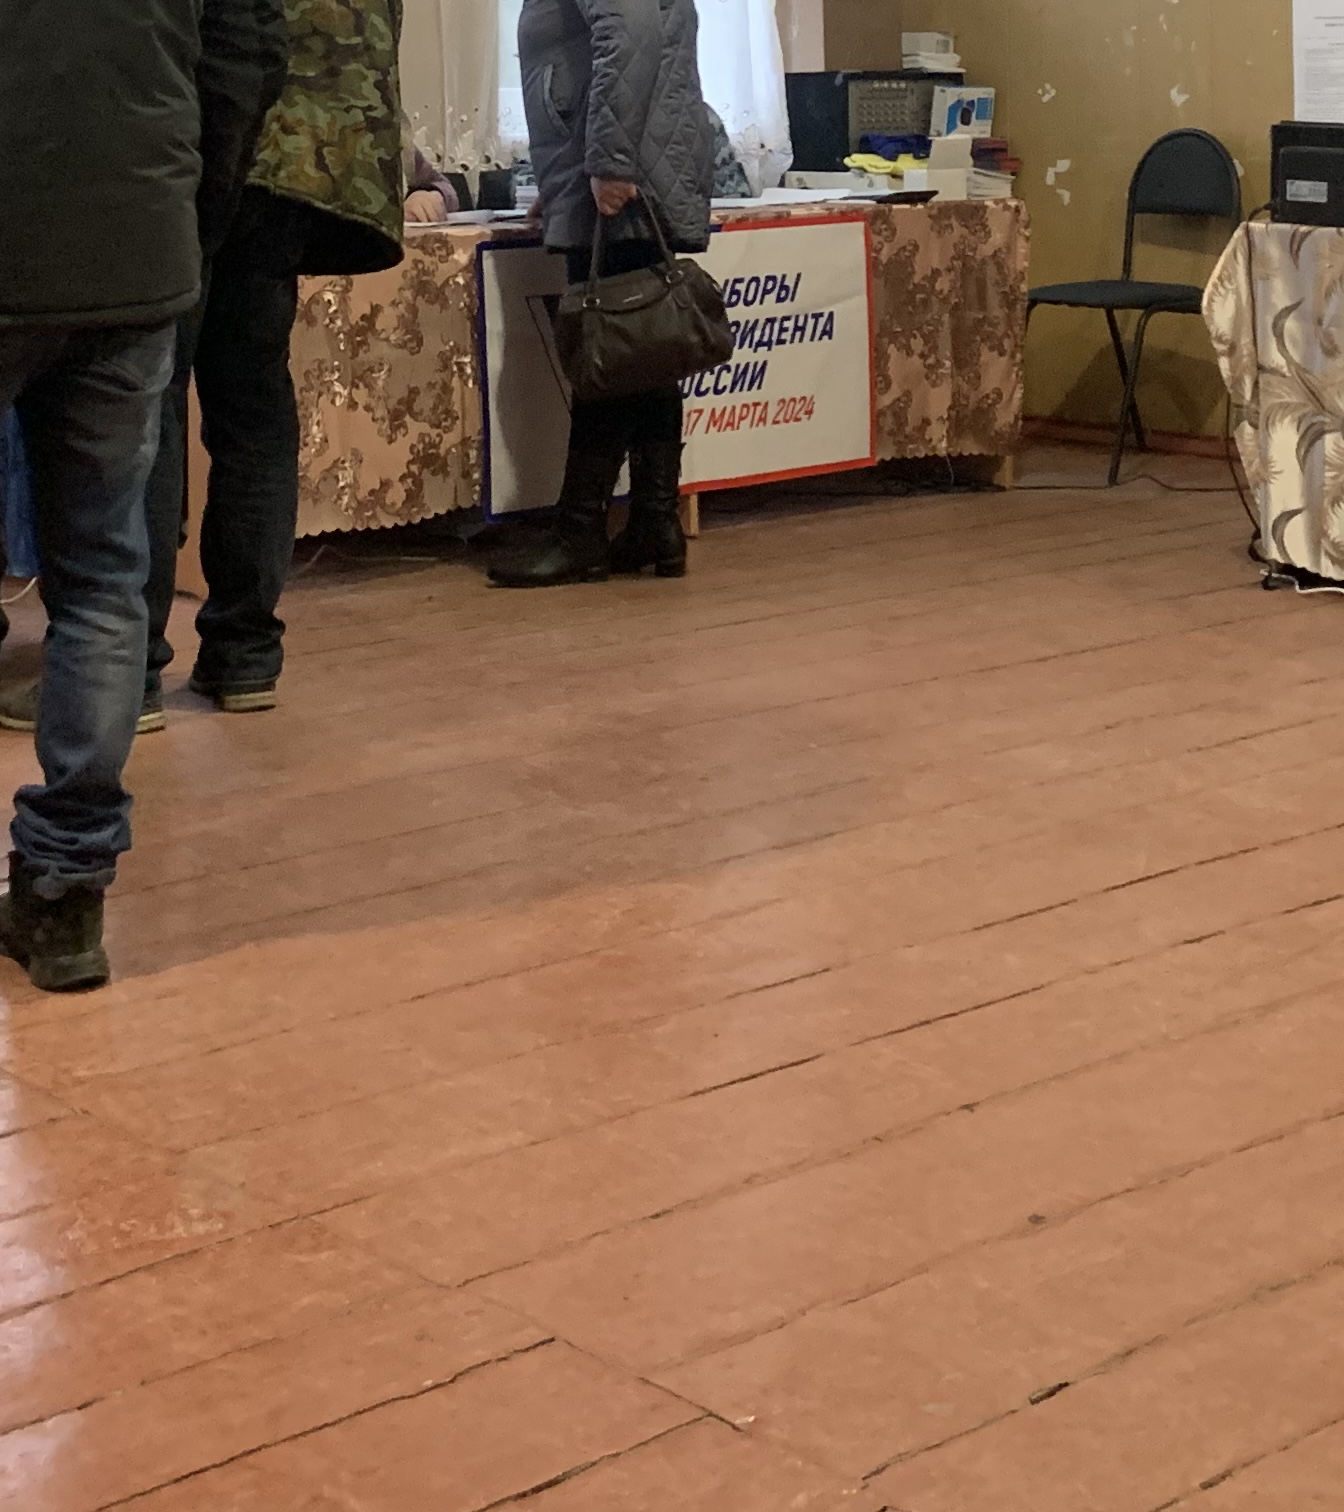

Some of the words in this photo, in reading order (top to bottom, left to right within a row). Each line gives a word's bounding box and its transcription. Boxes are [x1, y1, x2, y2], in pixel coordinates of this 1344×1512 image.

[723, 272, 802, 308] БОРЫ
[680, 360, 768, 399] ОССИИ
[704, 400, 769, 434] МАРТА
[771, 394, 816, 426] 2024
